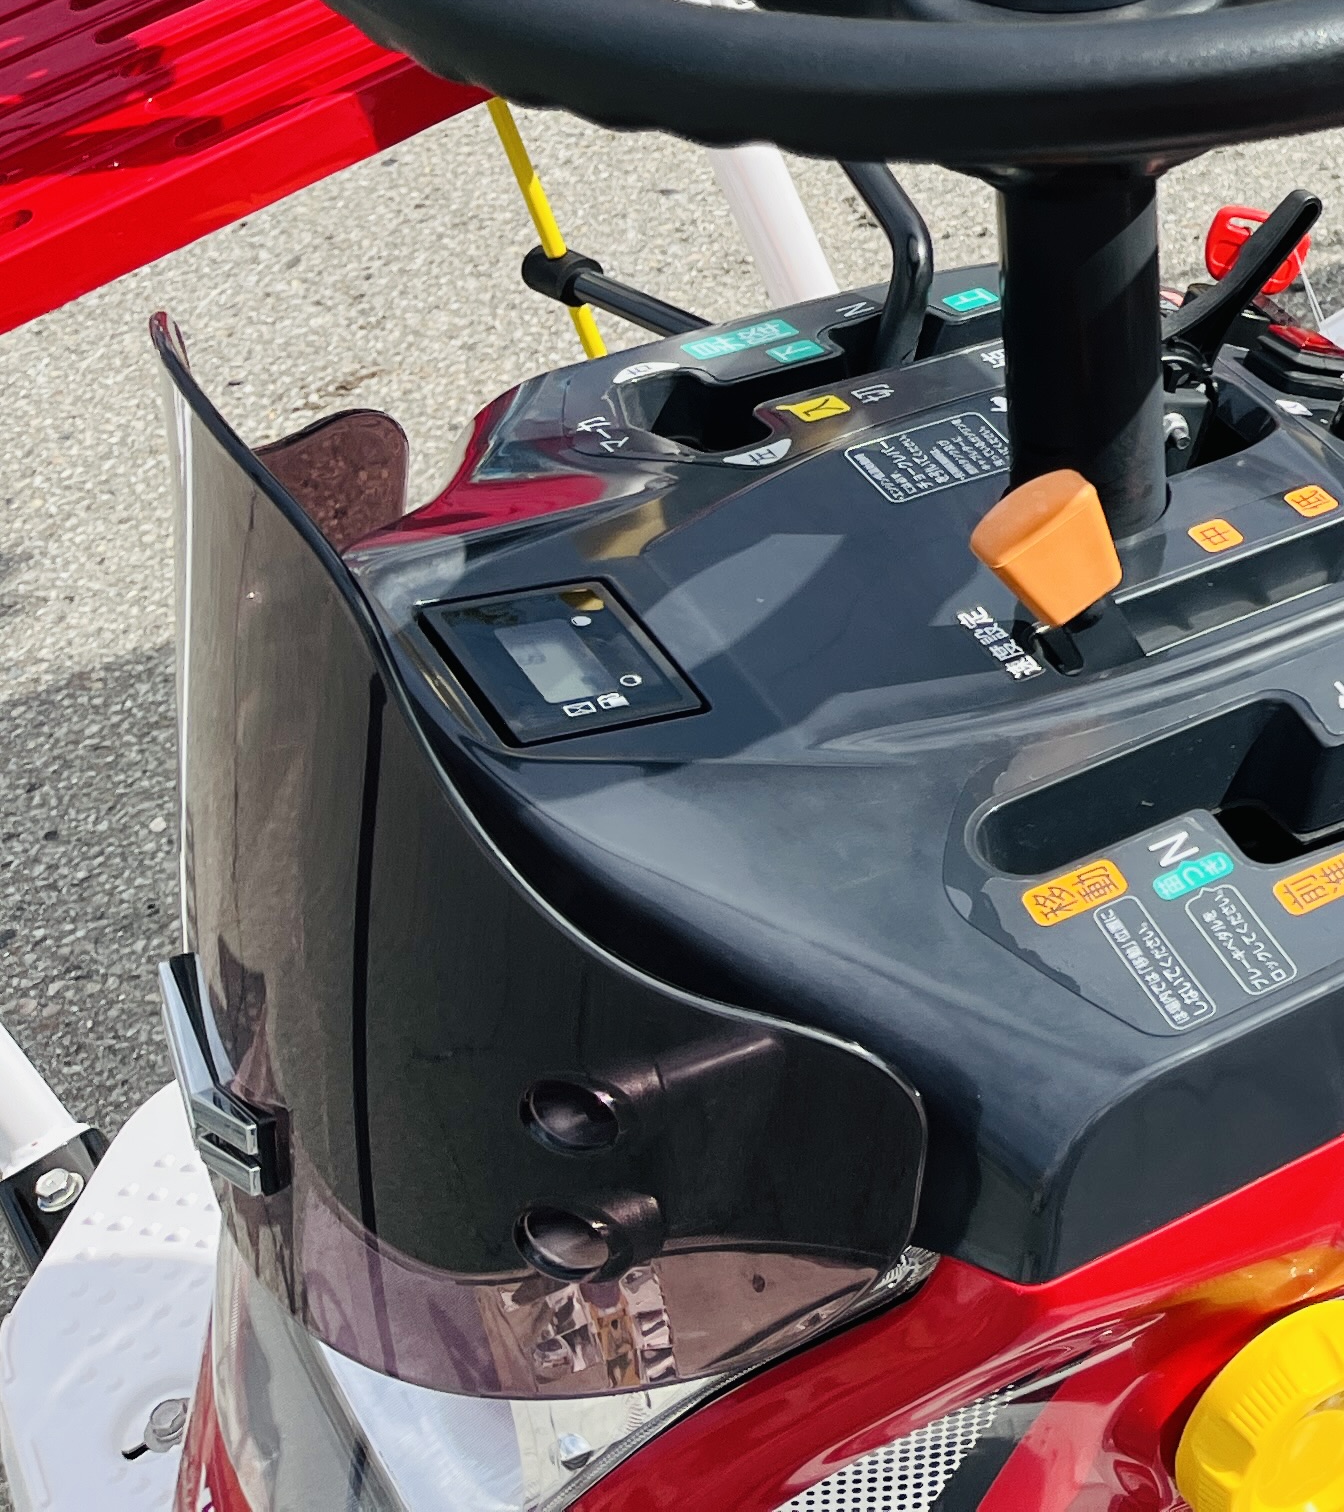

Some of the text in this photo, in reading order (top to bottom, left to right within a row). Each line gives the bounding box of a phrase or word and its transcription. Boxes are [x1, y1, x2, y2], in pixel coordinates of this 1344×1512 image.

[837, 301, 874, 319] N
[778, 342, 820, 361] 下
[801, 398, 844, 419] 入
[851, 384, 896, 406] 切
[574, 414, 626, 454] マーカ
[876, 439, 933, 490] チョークレバー
[1198, 523, 1235, 550] 中
[957, 605, 1043, 681] 速度設定
[1149, 831, 1199, 867] N
[1031, 864, 1122, 919] 移動
[1158, 854, 1232, 897] 苗つぎ
[1133, 920, 1208, 1016] しないでください。
[1201, 907, 1269, 990] ブレーキペダルを
